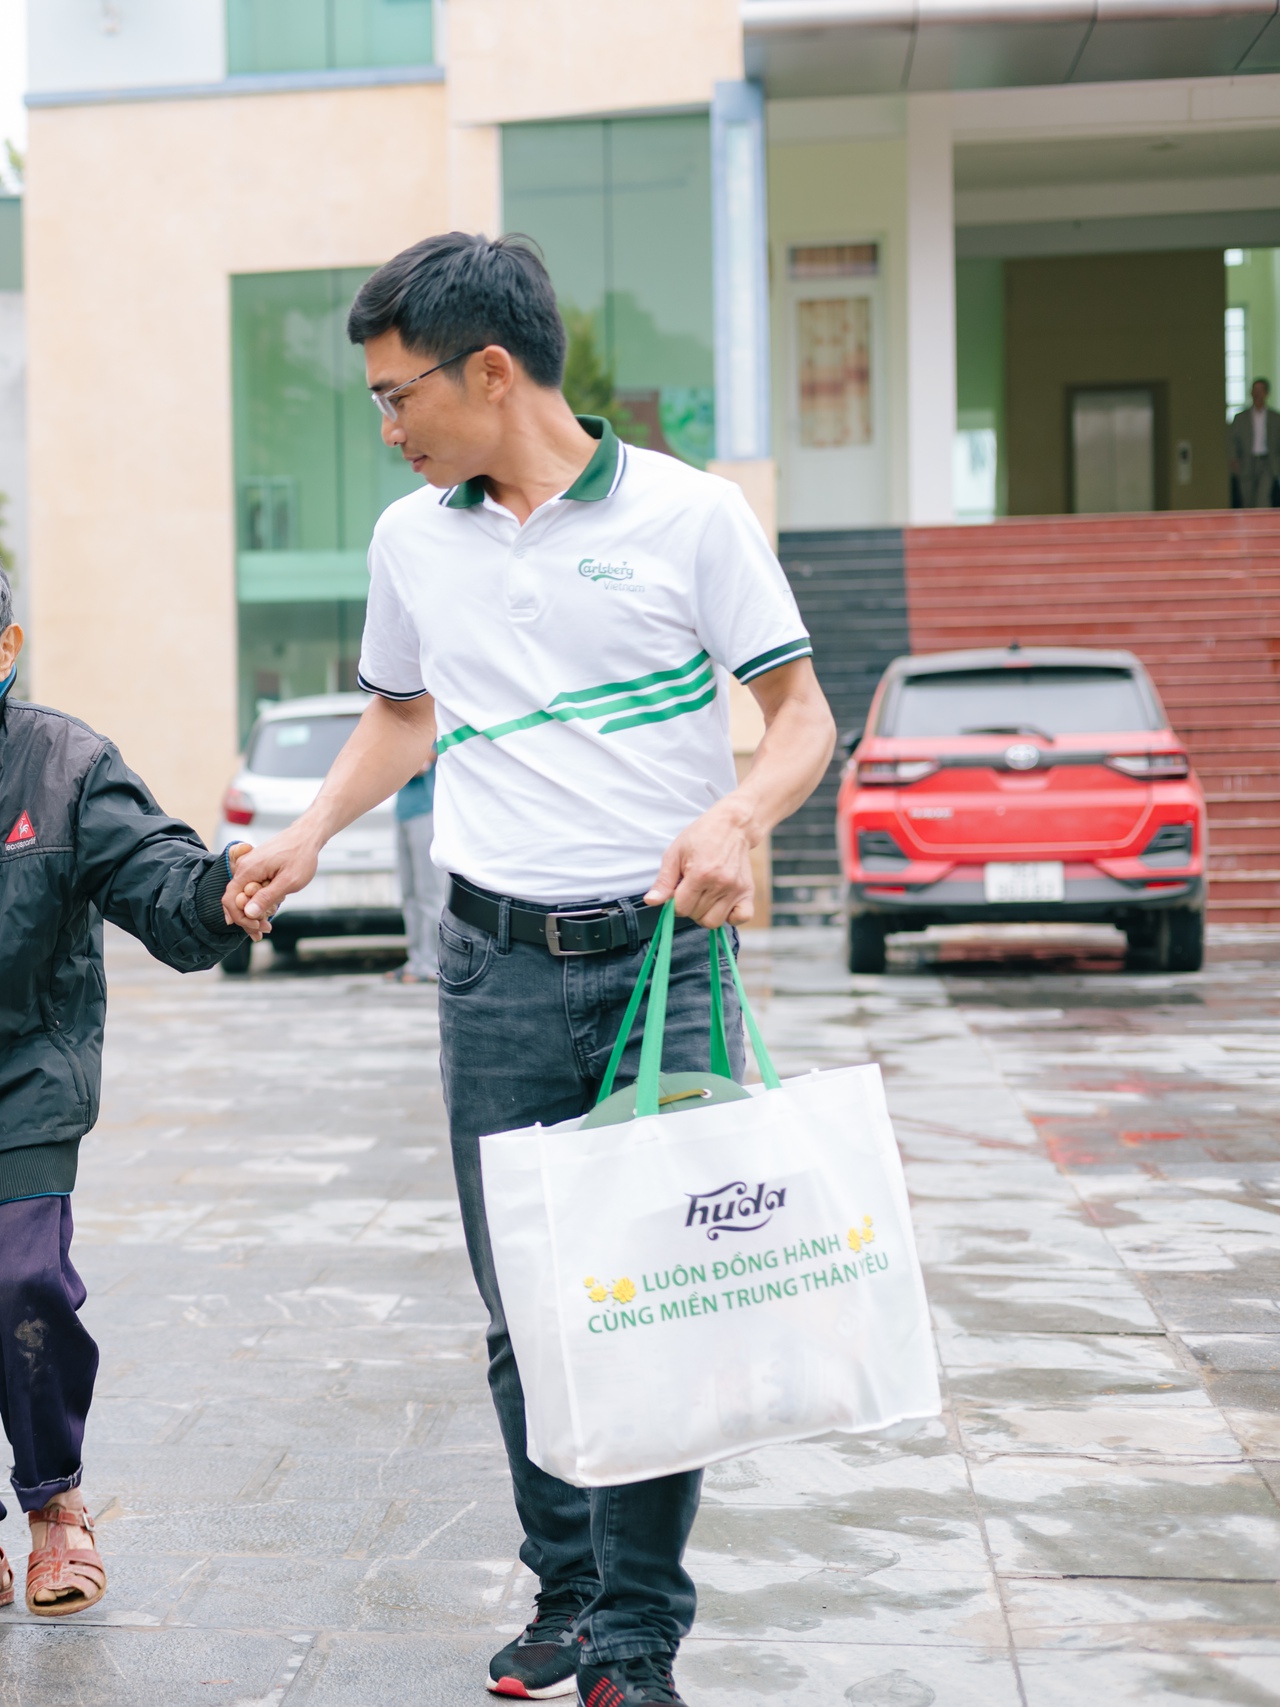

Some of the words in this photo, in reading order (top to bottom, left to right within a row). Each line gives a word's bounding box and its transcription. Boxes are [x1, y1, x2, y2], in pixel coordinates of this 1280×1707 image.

[579, 559, 634, 581] Carlsberg
[603, 580, 645, 592] Vietnam
[683, 1181, 787, 1241] huda
[642, 1264, 706, 1292] LUÔN
[712, 1251, 779, 1280] ĐỒNG
[783, 1234, 841, 1265] HÀNH
[588, 1306, 654, 1333] CÙNG
[660, 1291, 718, 1321] MIỀN
[721, 1278, 798, 1310] TRUNG
[800, 1262, 858, 1293] THÂN
